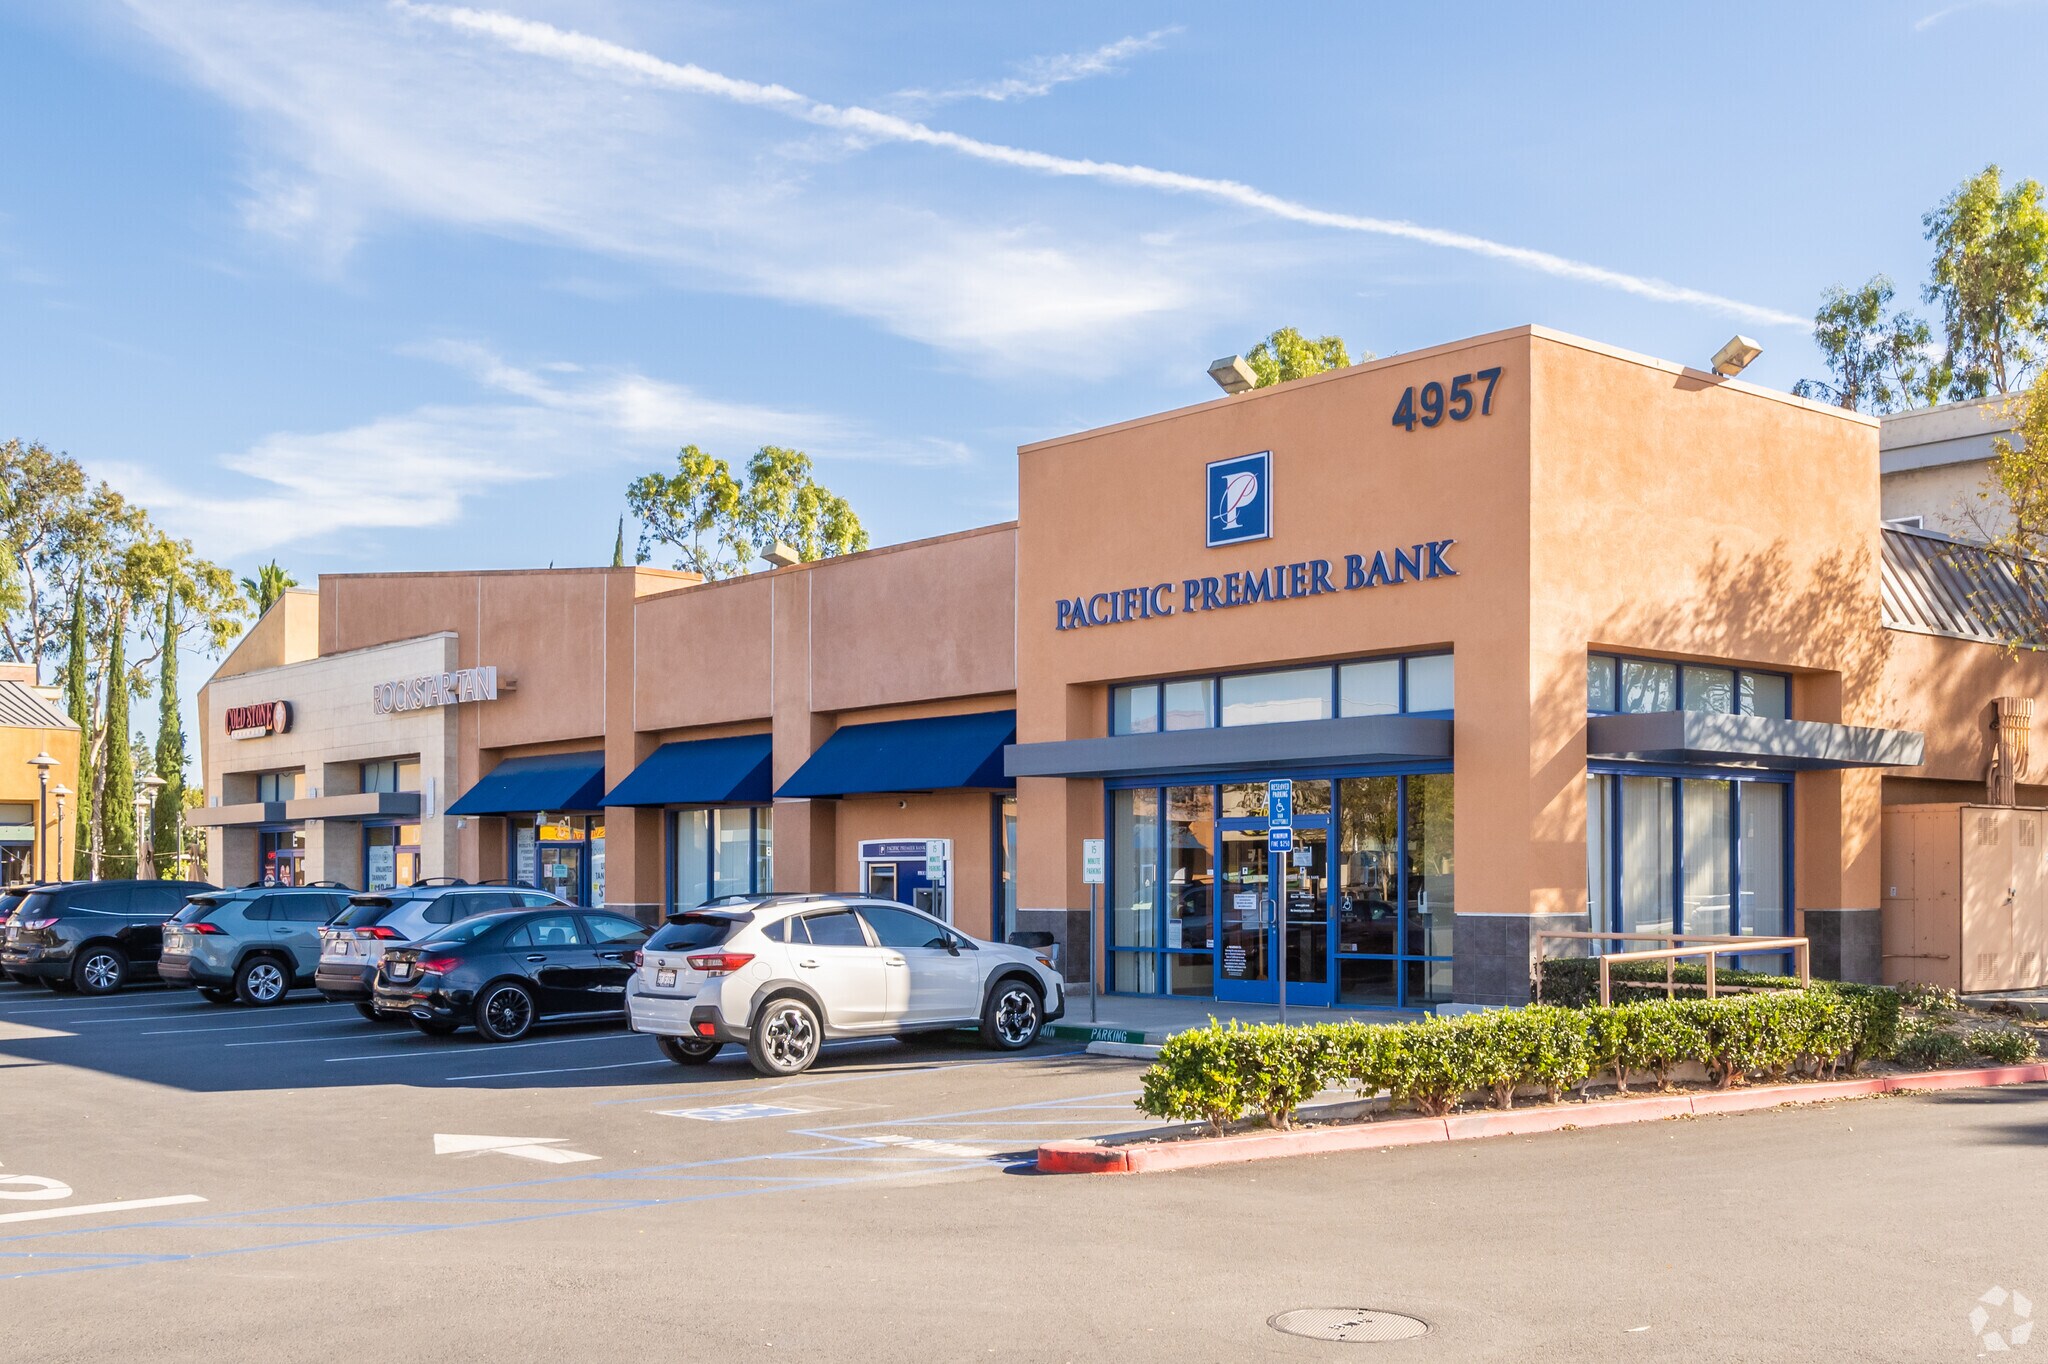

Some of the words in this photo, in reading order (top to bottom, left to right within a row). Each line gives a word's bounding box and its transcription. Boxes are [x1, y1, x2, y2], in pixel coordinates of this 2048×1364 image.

[1392, 366, 1503, 432] 4957
[1056, 583, 1176, 630] PACIFIC
[1182, 559, 1338, 613] PREMIER
[1344, 539, 1460, 590] BANK
[373, 672, 457, 715] ROCKSTAR
[456, 666, 497, 703] TAN
[225, 706, 246, 736] COLD
[246, 702, 273, 730] STONE
[1092, 845, 1097, 854] 15
[1040, 1026, 1055, 1037] MIN
[1091, 1028, 1127, 1042] PARKING
